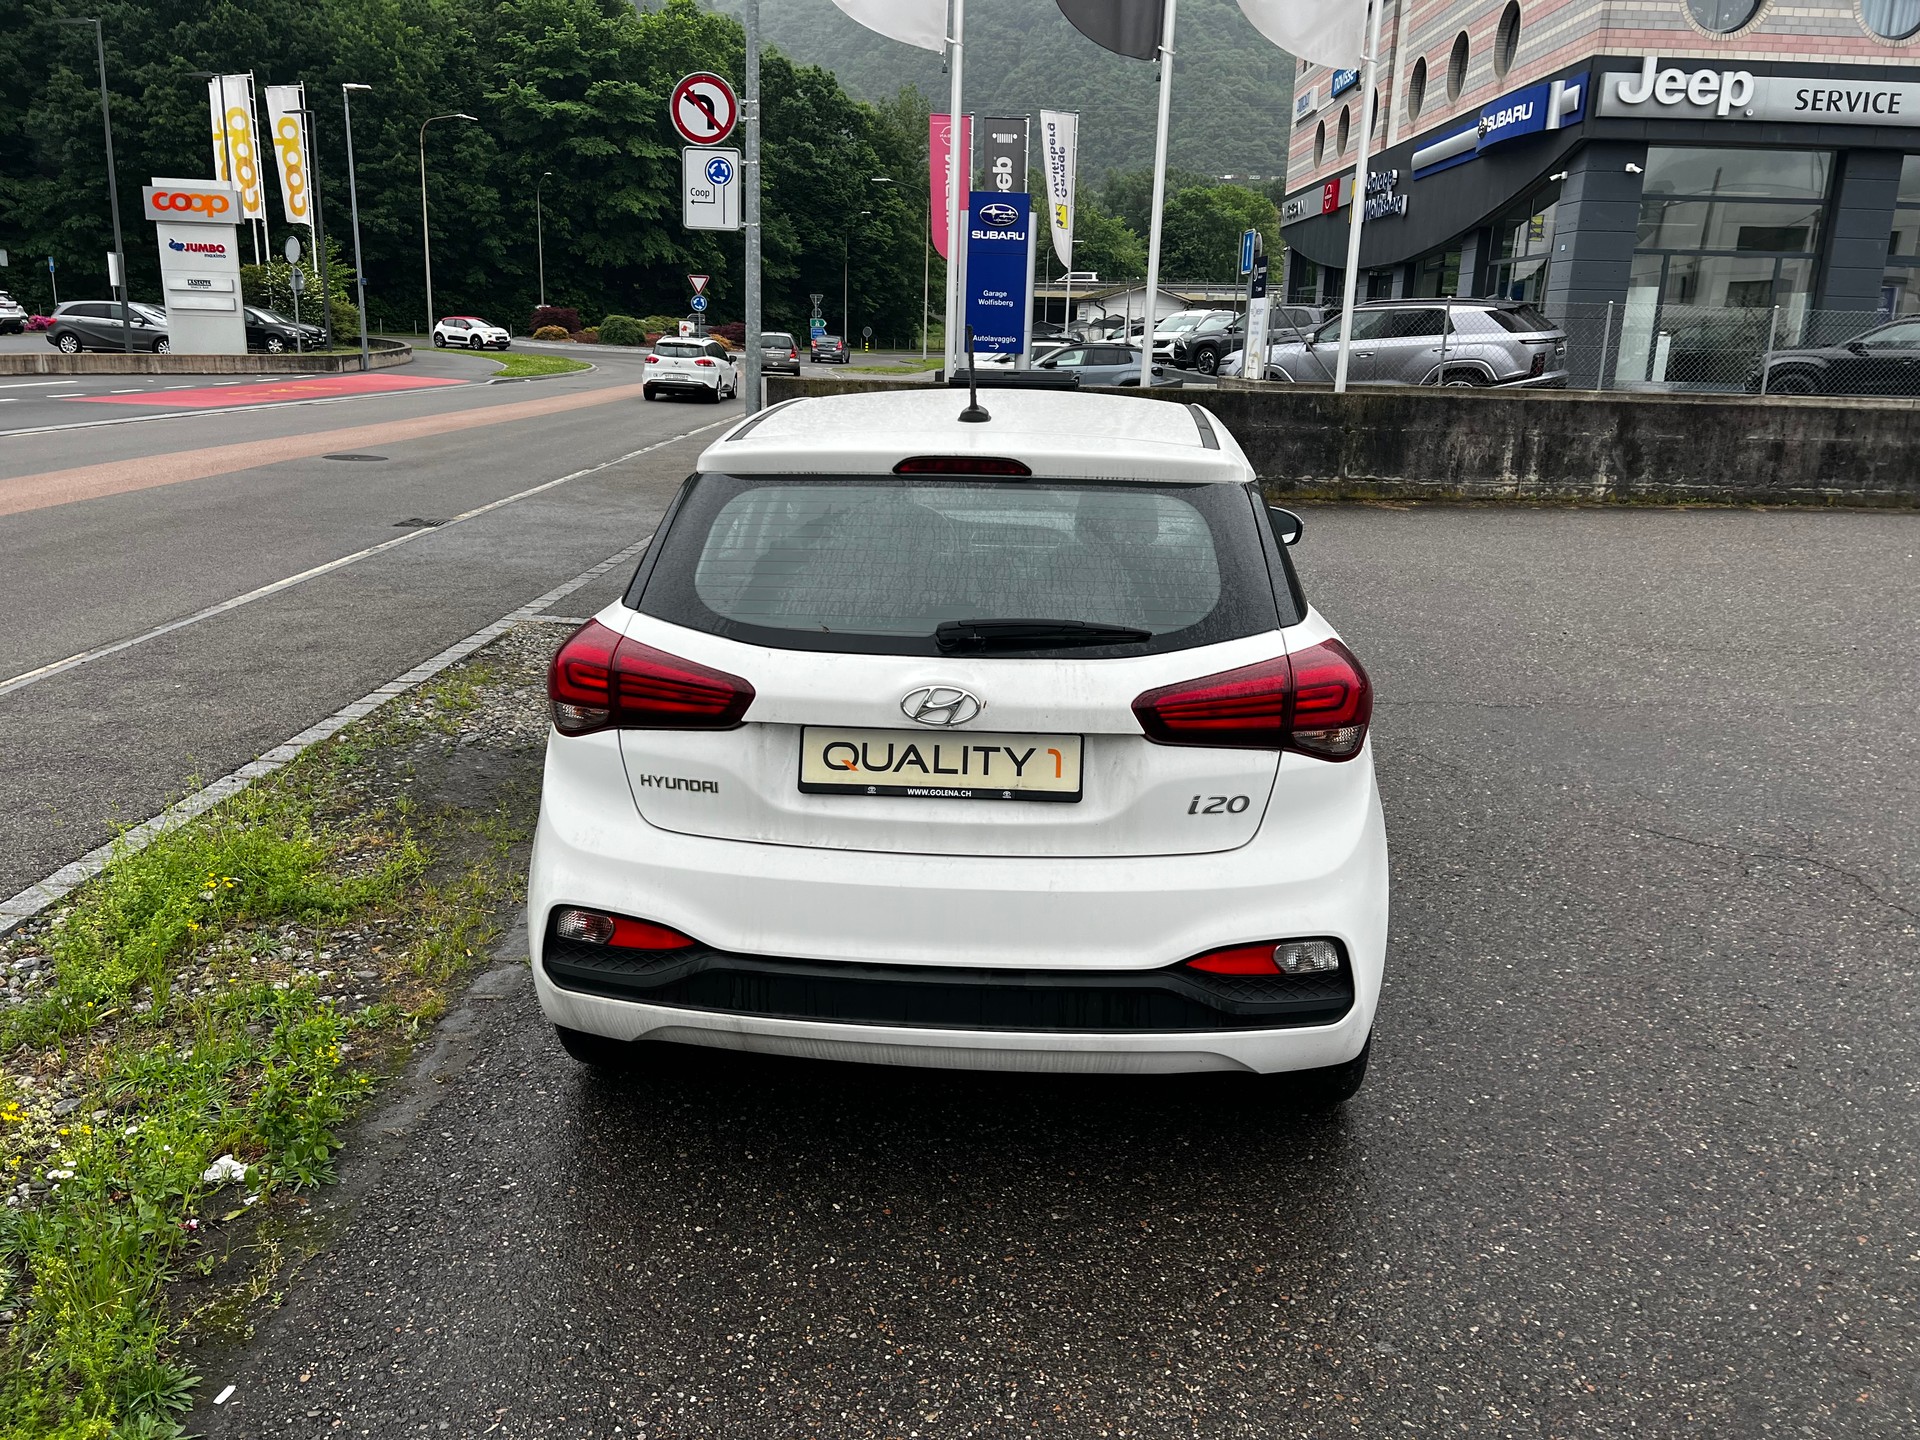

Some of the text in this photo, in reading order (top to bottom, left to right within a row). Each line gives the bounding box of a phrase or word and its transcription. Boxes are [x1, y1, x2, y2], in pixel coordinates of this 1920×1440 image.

[1617, 56, 1903, 116] Jeep SERVICE
[1486, 101, 1534, 132] SUBARU
[690, 187, 710, 199] Coop
[151, 191, 230, 218] coop
[971, 230, 1026, 241] SUBARU
[183, 243, 226, 253] JUMBO
[983, 290, 1008, 298] Garage
[978, 299, 1014, 307] Wolfisberg
[972, 334, 1017, 344] Autolavaggio
[822, 741, 1037, 777] QUALITY
[640, 773, 719, 794] HYUNDAI
[907, 788, 972, 798] WWW.GOLENA.CH
[1187, 795, 1250, 815] i20
